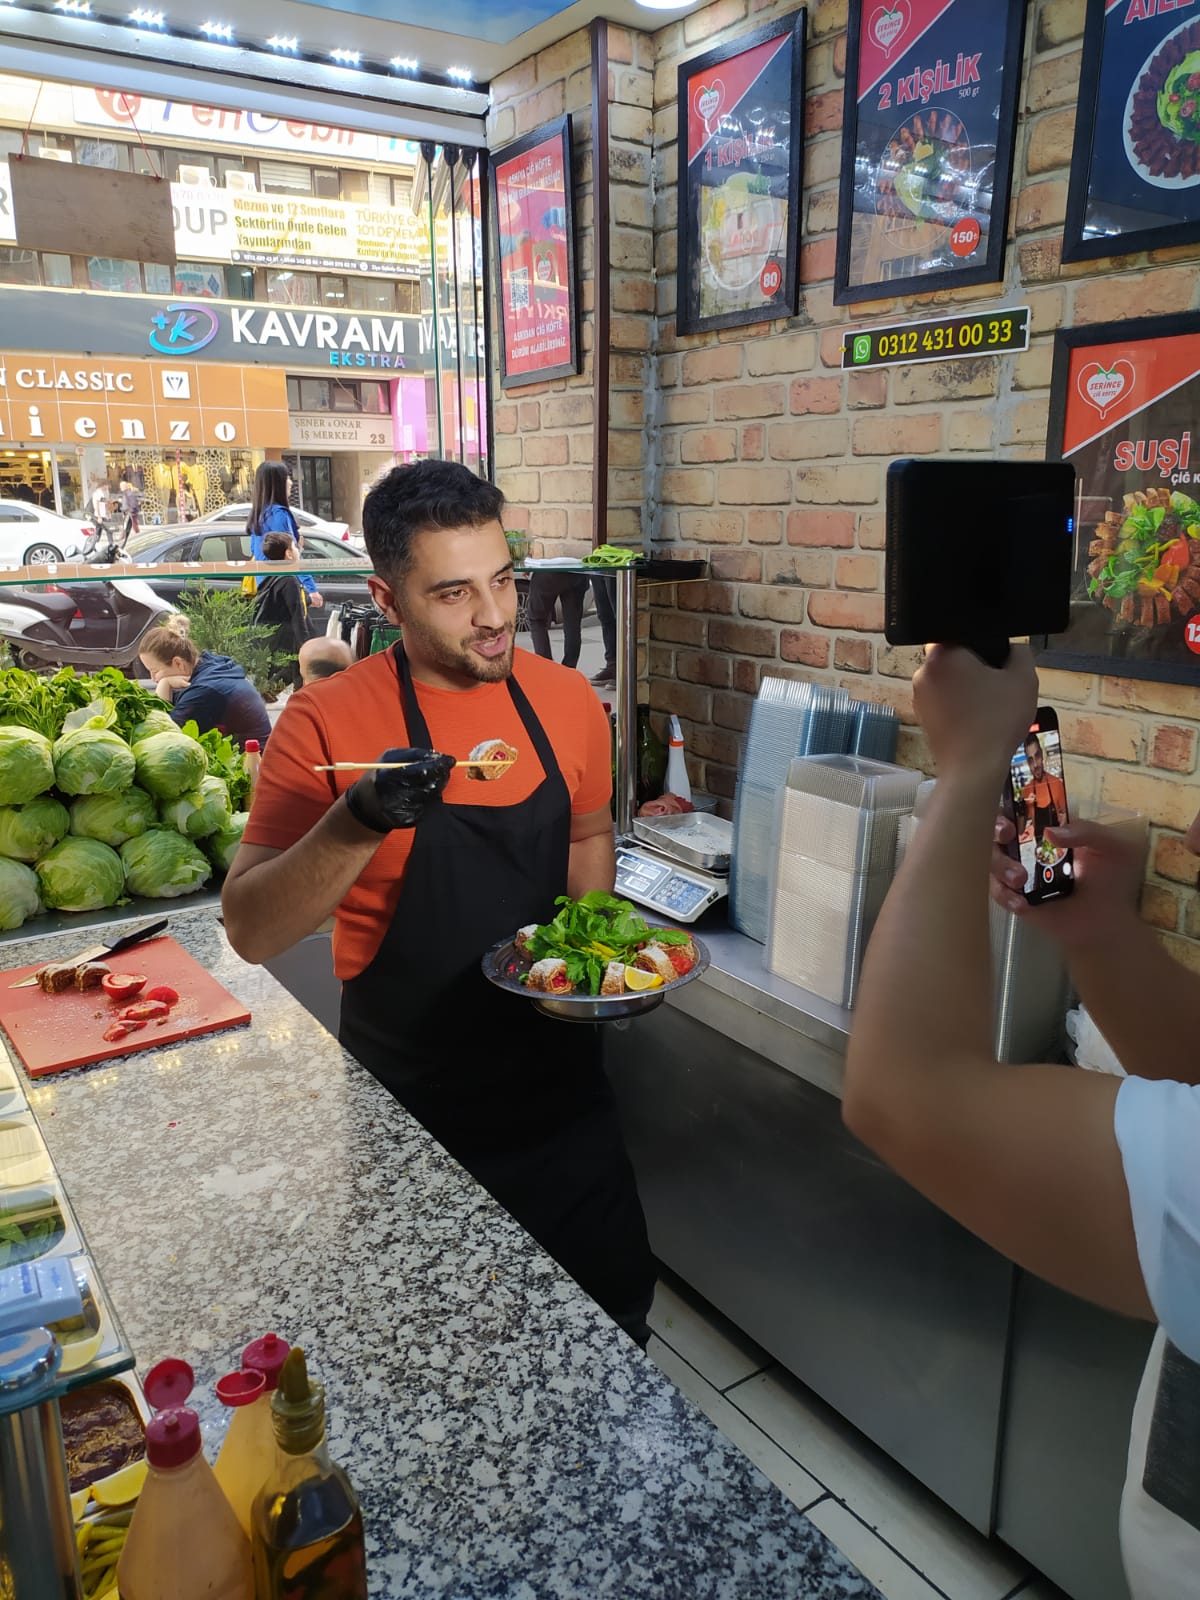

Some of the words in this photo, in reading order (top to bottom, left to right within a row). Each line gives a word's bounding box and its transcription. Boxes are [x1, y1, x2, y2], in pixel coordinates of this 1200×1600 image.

[877, 82, 892, 111] 2
[897, 52, 983, 105] KİŞİLİK
[958, 88, 971, 99] 500
[704, 148, 712, 171] 1
[233, 199, 269, 212] Mezun
[271, 202, 284, 214] ve
[299, 204, 346, 220] Sınıflara
[234, 215, 285, 231] Sektörün
[287, 219, 315, 234] Önde
[317, 221, 348, 237] Gelen
[237, 233, 312, 251] Yayınlarından
[231, 307, 406, 354] KAVRAM
[878, 332, 918, 357] 0312
[922, 327, 954, 351] 431
[959, 322, 983, 346] 00
[988, 319, 1012, 344] 33
[329, 351, 406, 369] EKSTRA
[15, 368, 135, 392] CLASSIC
[1089, 380, 1122, 391] SERİNCE
[294, 418, 325, 429] ŞENER
[333, 419, 362, 429] ONAR
[300, 429, 310, 441] İŞ
[313, 430, 358, 441] MERKEZİ
[370, 433, 386, 445] 23
[1114, 431, 1191, 478] SUŞİ
[1171, 471, 1191, 486] ÇİĞ
